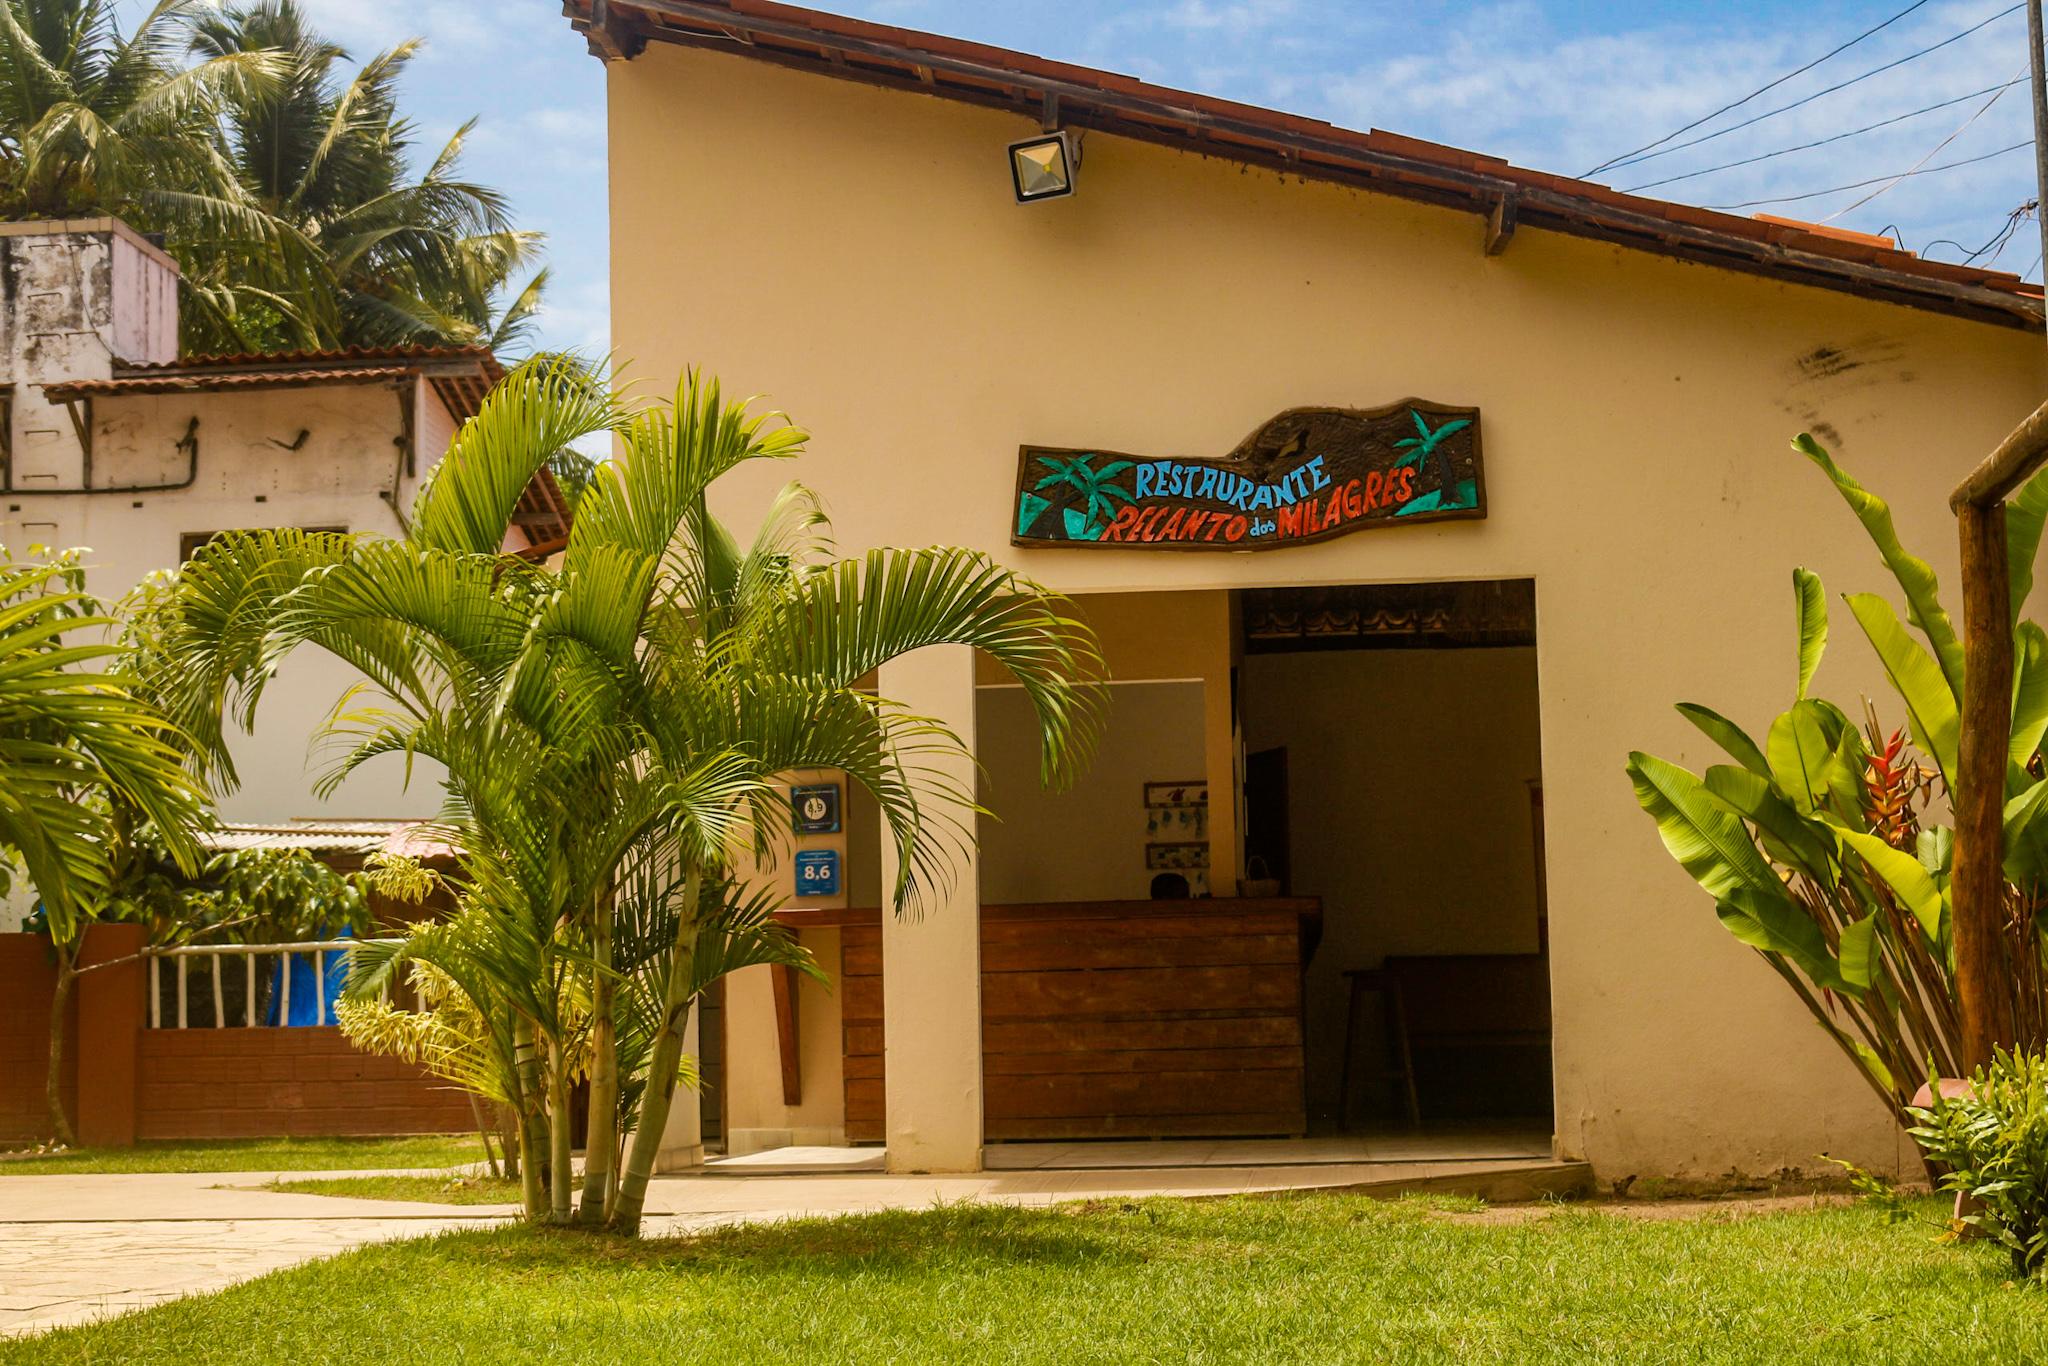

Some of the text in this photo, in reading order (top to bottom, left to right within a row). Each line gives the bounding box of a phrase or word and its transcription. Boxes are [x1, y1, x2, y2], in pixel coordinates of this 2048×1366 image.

[1099, 466, 1416, 542] RECANTO dos MILAGRES
[1136, 455, 1331, 511] RESTAURANTE
[804, 865, 831, 880] 8,6
